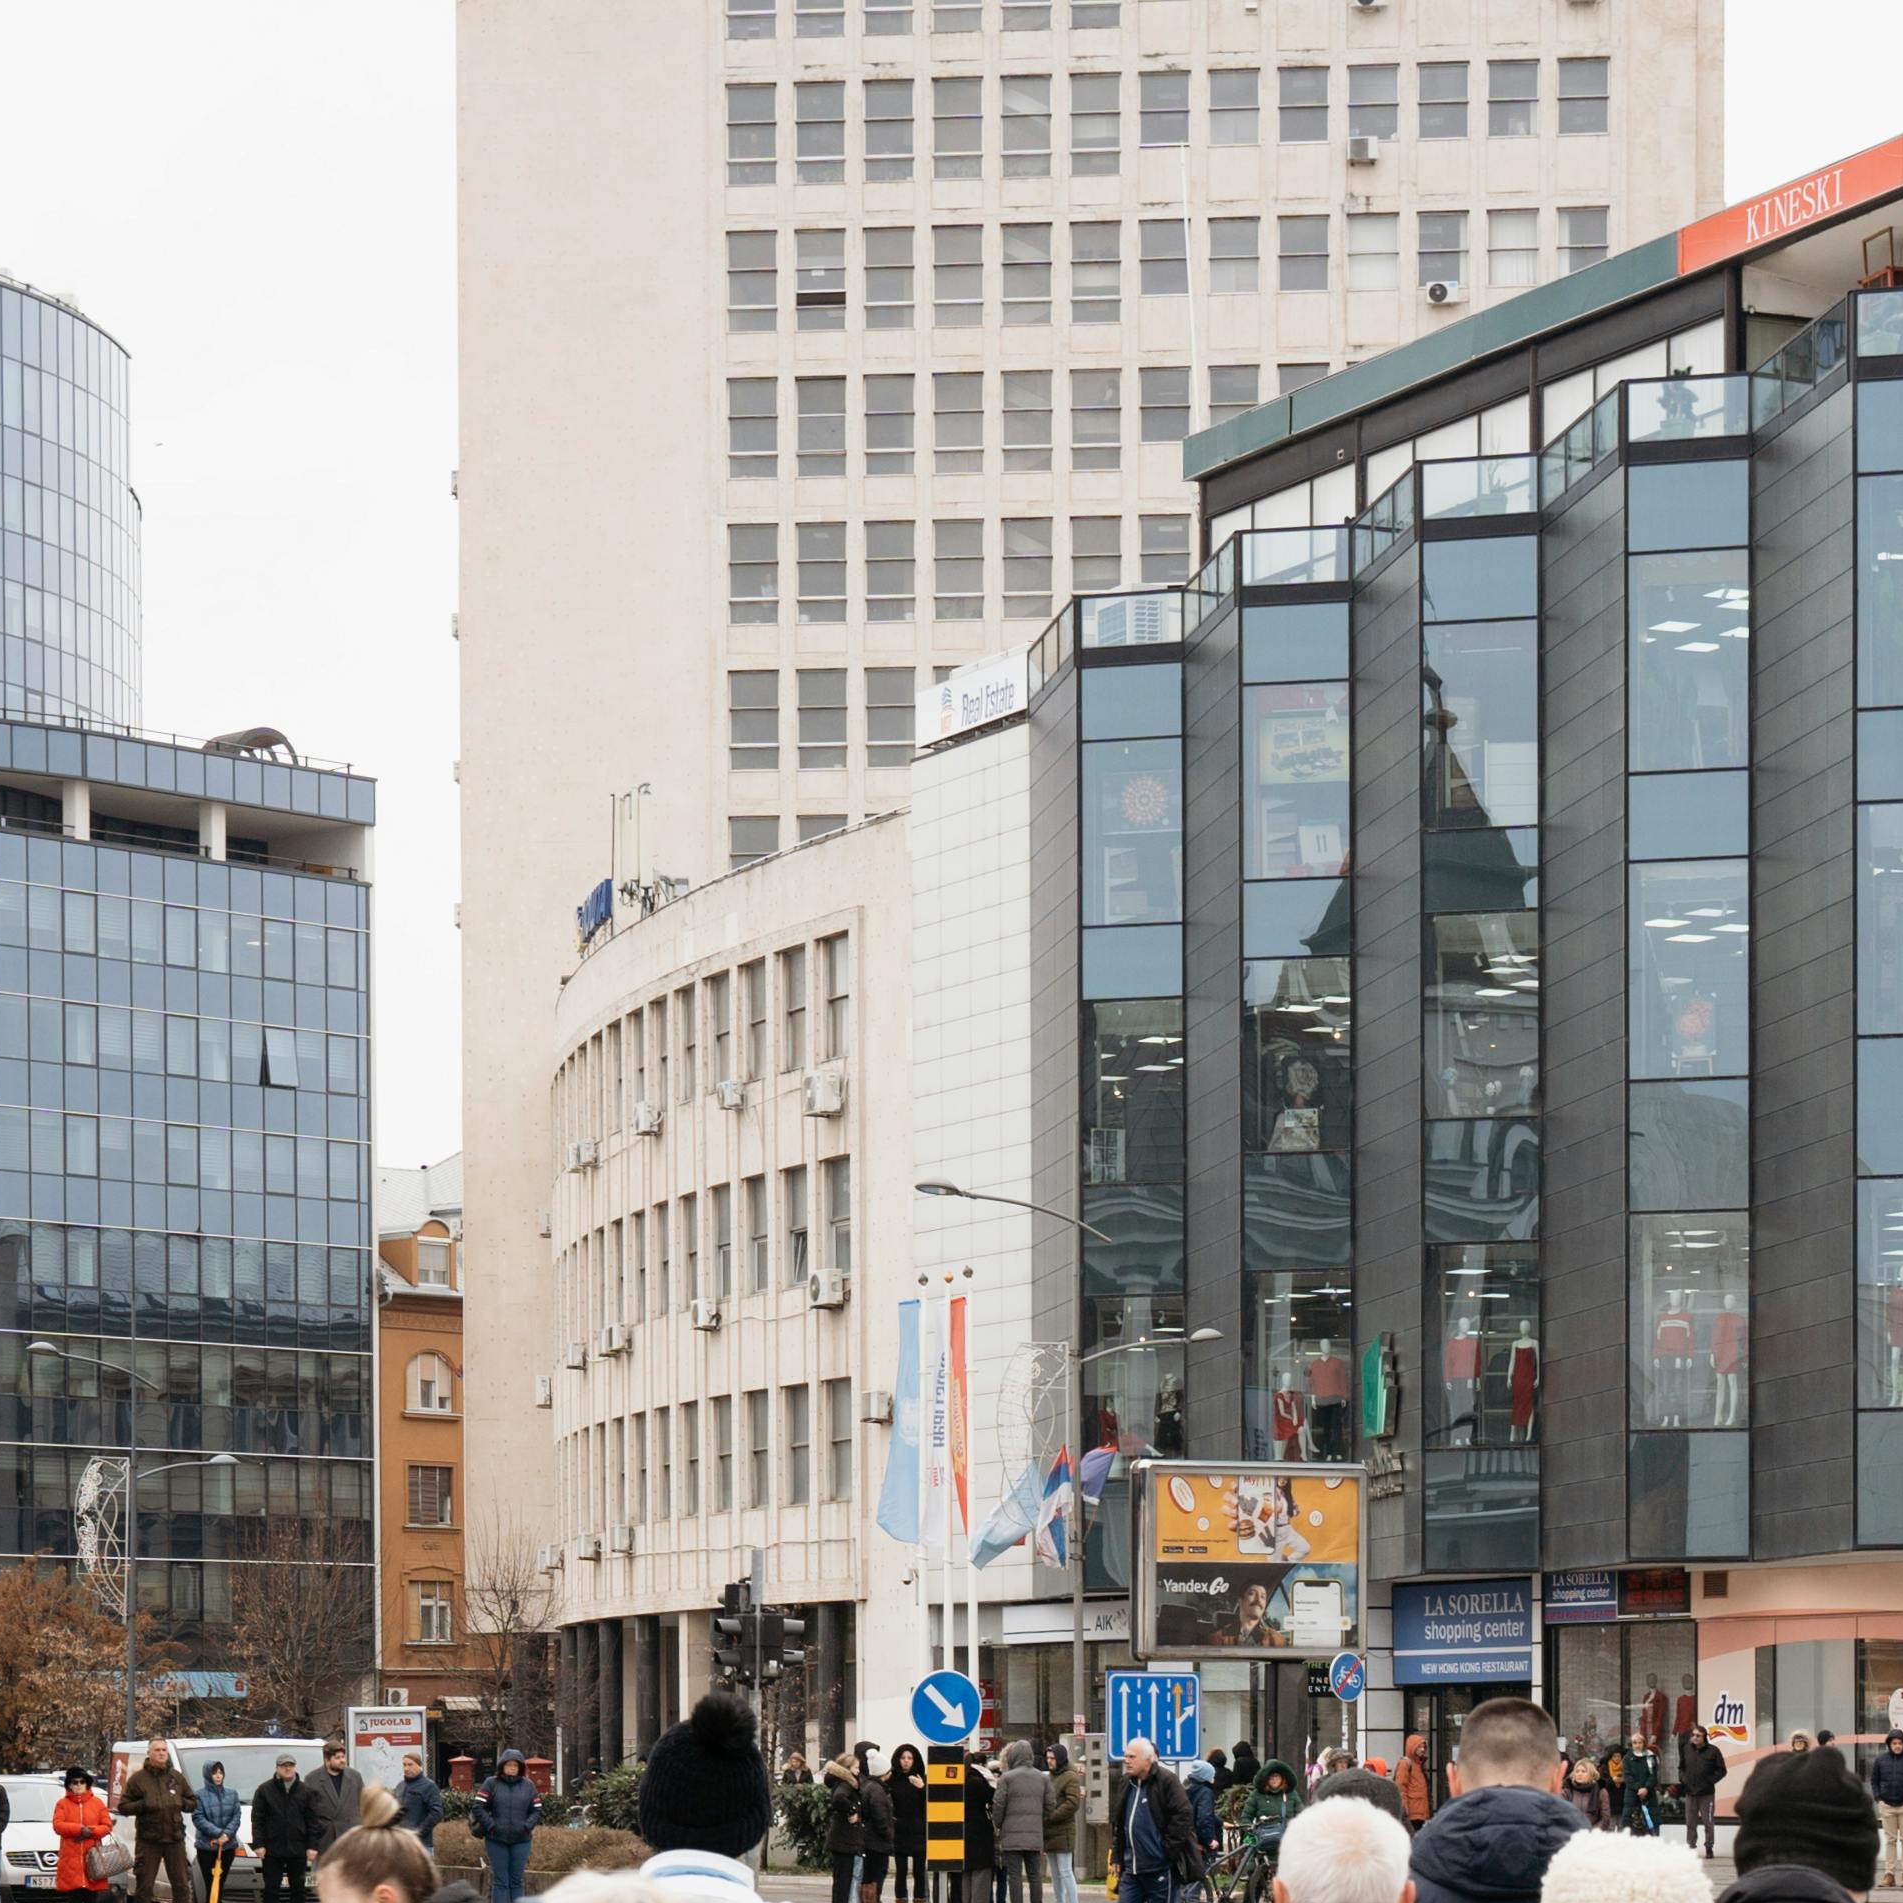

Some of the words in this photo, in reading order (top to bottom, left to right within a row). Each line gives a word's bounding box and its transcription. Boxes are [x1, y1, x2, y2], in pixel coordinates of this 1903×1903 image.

[1745, 168, 1844, 243] KINESKI
[961, 687, 983, 727] Real
[985, 677, 1014, 718] Estate
[1163, 1578, 1209, 1593] Yandex
[1209, 1576, 1230, 1595] Go
[1553, 1575, 1564, 1586] LA
[1566, 1572, 1610, 1586] SORELLA
[1553, 1589, 1586, 1601] shopping
[1587, 1587, 1610, 1598] center
[1424, 1596, 1445, 1616] LA
[1449, 1592, 1525, 1615] SORELLA
[1095, 1615, 1113, 1631] AIK
[1424, 1620, 1482, 1643] shopping
[1485, 1618, 1525, 1637] center
[1421, 1664, 1438, 1674] NEW
[1439, 1663, 1459, 1674] HONG
[1460, 1662, 1480, 1673] KONG
[1482, 1661, 1528, 1672] RESTAURANT
[1714, 1694, 1744, 1724] dm
[369, 1718, 412, 1727] JUGOLAB
